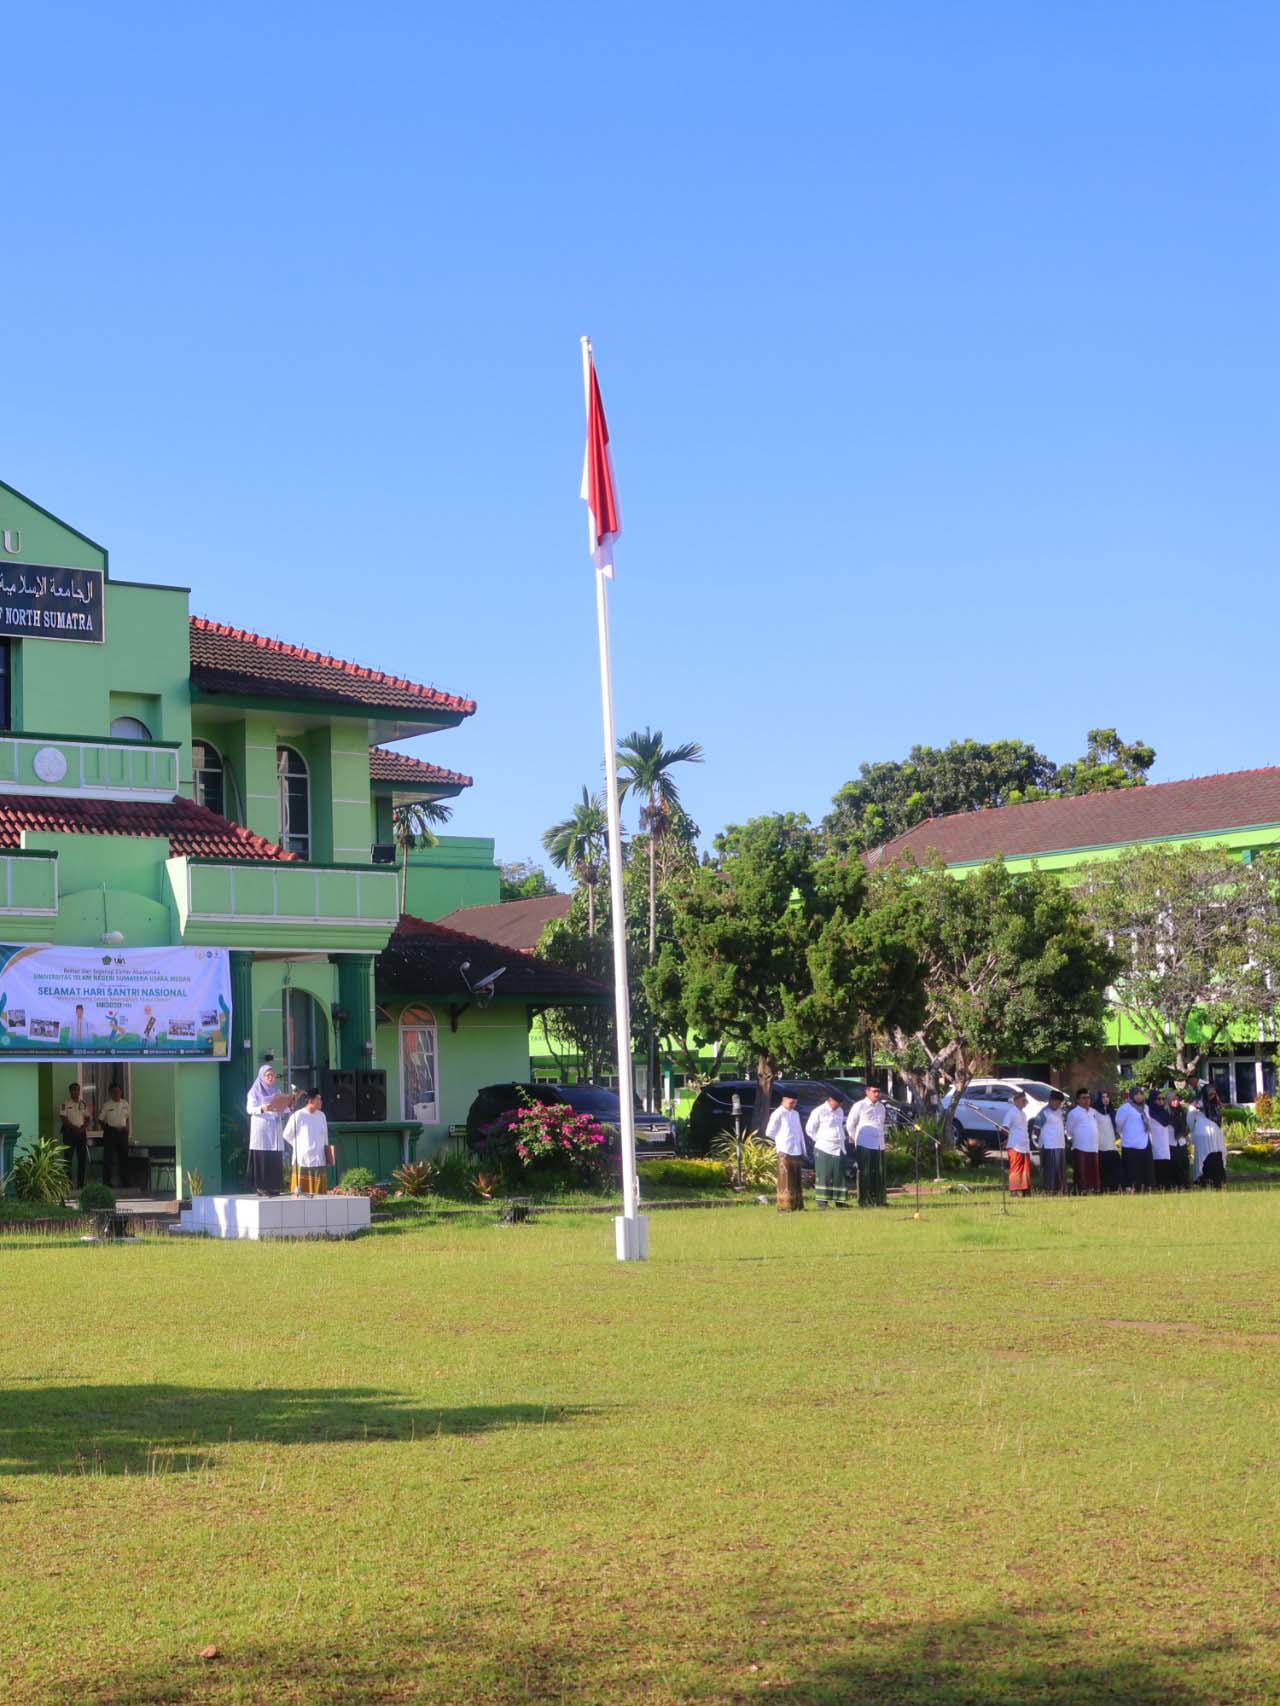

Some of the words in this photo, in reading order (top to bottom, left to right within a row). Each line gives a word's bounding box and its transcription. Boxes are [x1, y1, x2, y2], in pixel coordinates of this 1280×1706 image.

[6, 607, 41, 628] NORTH
[43, 610, 94, 631] SUMATRA
[38, 986, 81, 996] SELAMAT
[83, 987, 106, 996] HARI
[107, 987, 140, 997] SANTRI
[142, 988, 187, 998] NASIONAL
